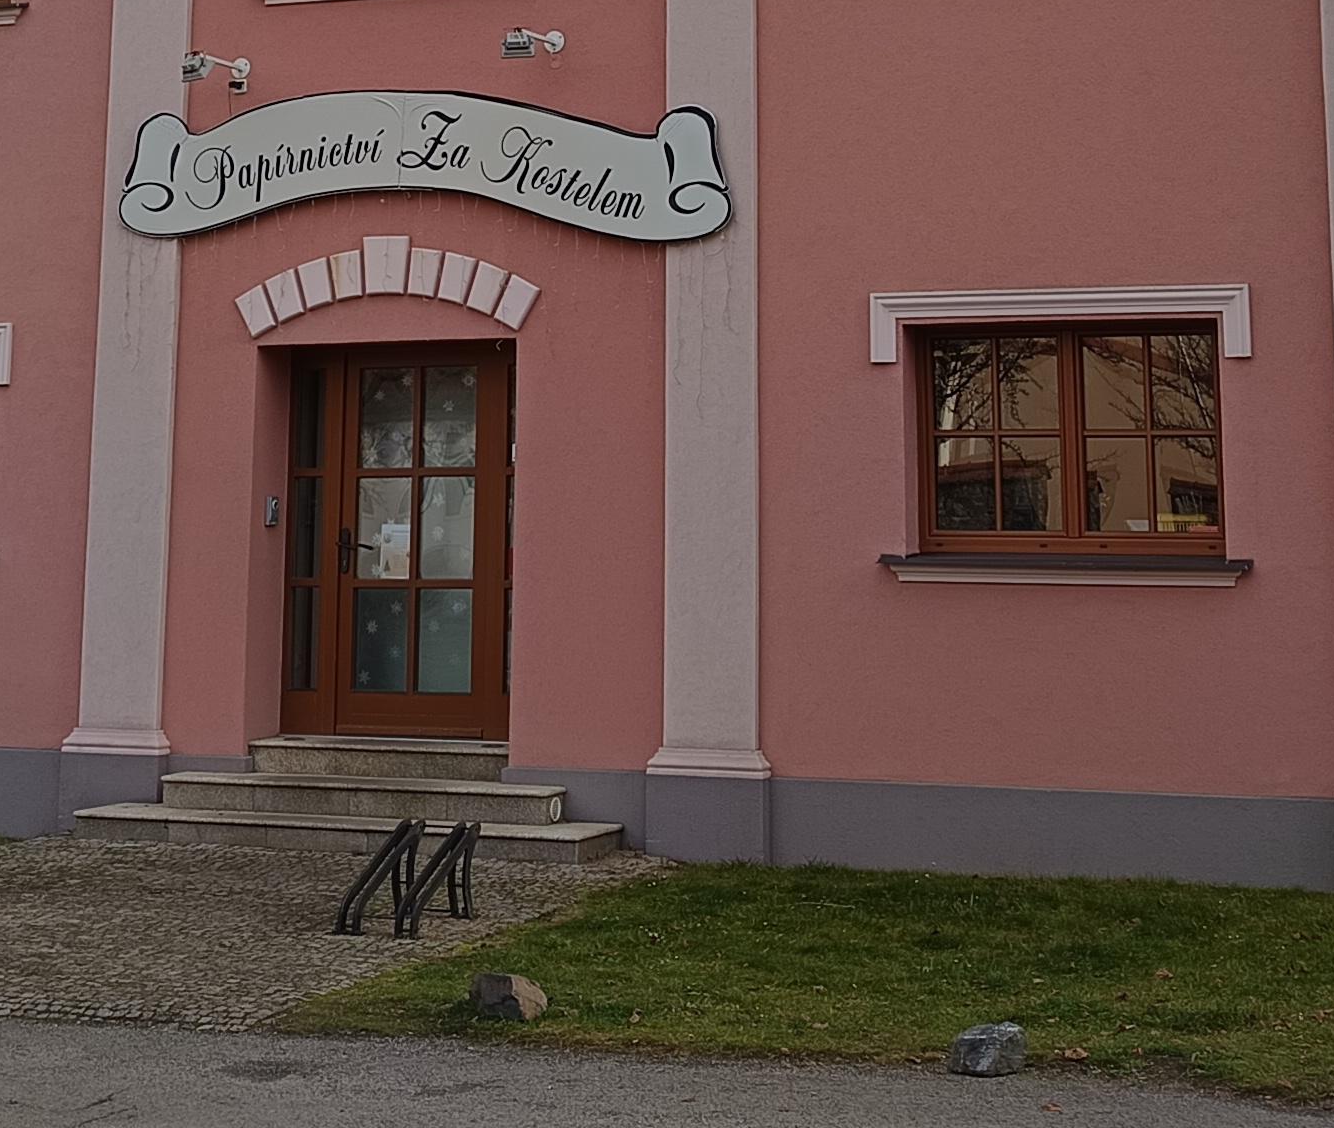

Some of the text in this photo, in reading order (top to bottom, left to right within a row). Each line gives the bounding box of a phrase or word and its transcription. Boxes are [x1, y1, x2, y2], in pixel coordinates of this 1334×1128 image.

[185, 110, 646, 220] Papírnictví Za Kostelem
